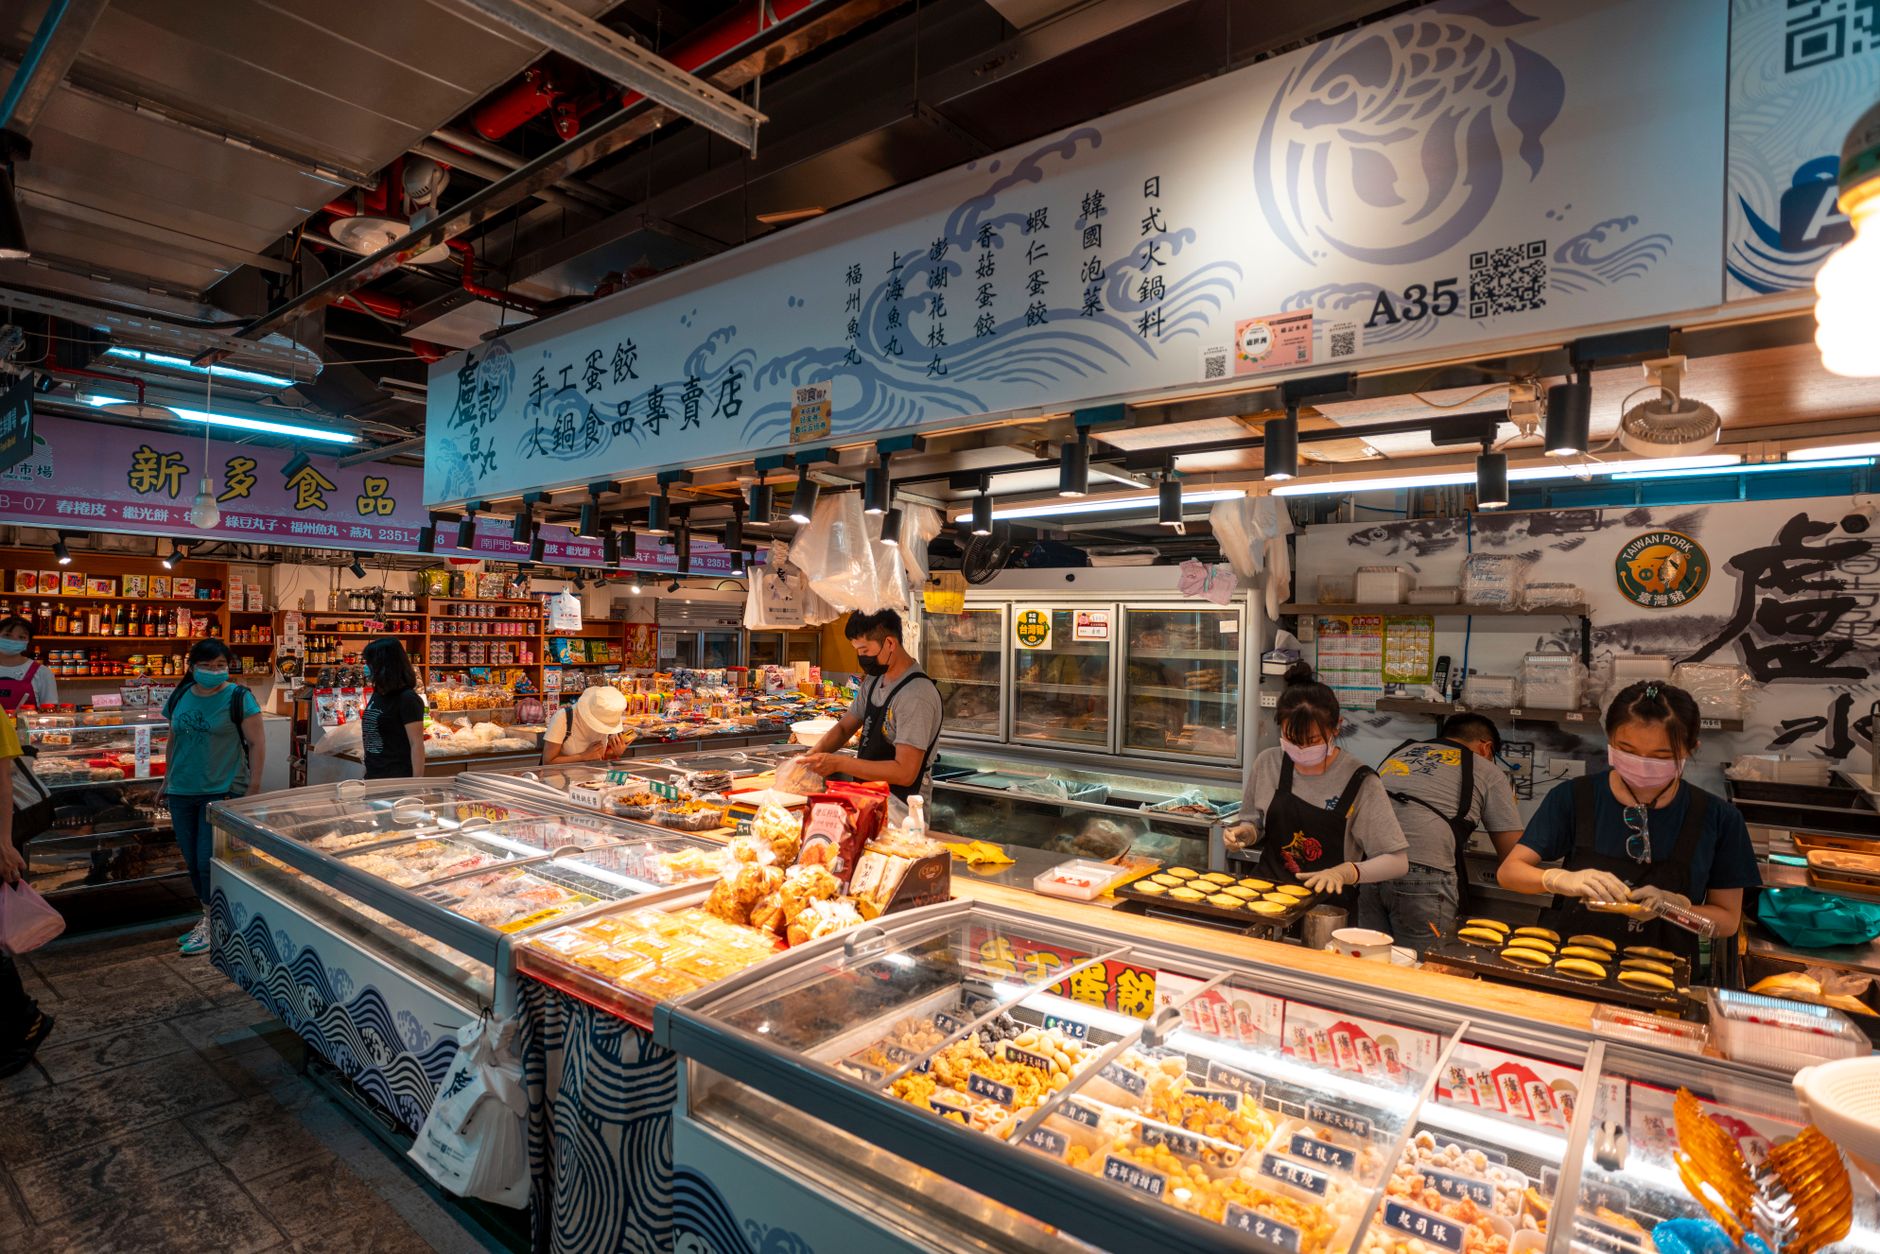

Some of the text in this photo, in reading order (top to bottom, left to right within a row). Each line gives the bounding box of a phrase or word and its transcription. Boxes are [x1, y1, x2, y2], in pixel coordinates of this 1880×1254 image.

[883, 250, 904, 359] 上海魚丸
[974, 222, 998, 339] 香菇蛋餃
[1024, 206, 1050, 328] 蝦仁蛋餃
[1080, 189, 1106, 318] 韓國泡菜
[1138, 175, 1168, 339] 日式火鍋料
[1363, 277, 1460, 328] A35
[843, 262, 863, 367] 福州魚丸
[926, 236, 949, 378] 澎湖花枝丸
[526, 365, 744, 460] 火鍋食品專賣店
[528, 337, 640, 408] 手工蛋餃
[128, 444, 398, 517] 新多食品
[1622, 534, 1694, 560] TAIWAN PORK
[1397, 1211, 1448, 1242] 起司球
